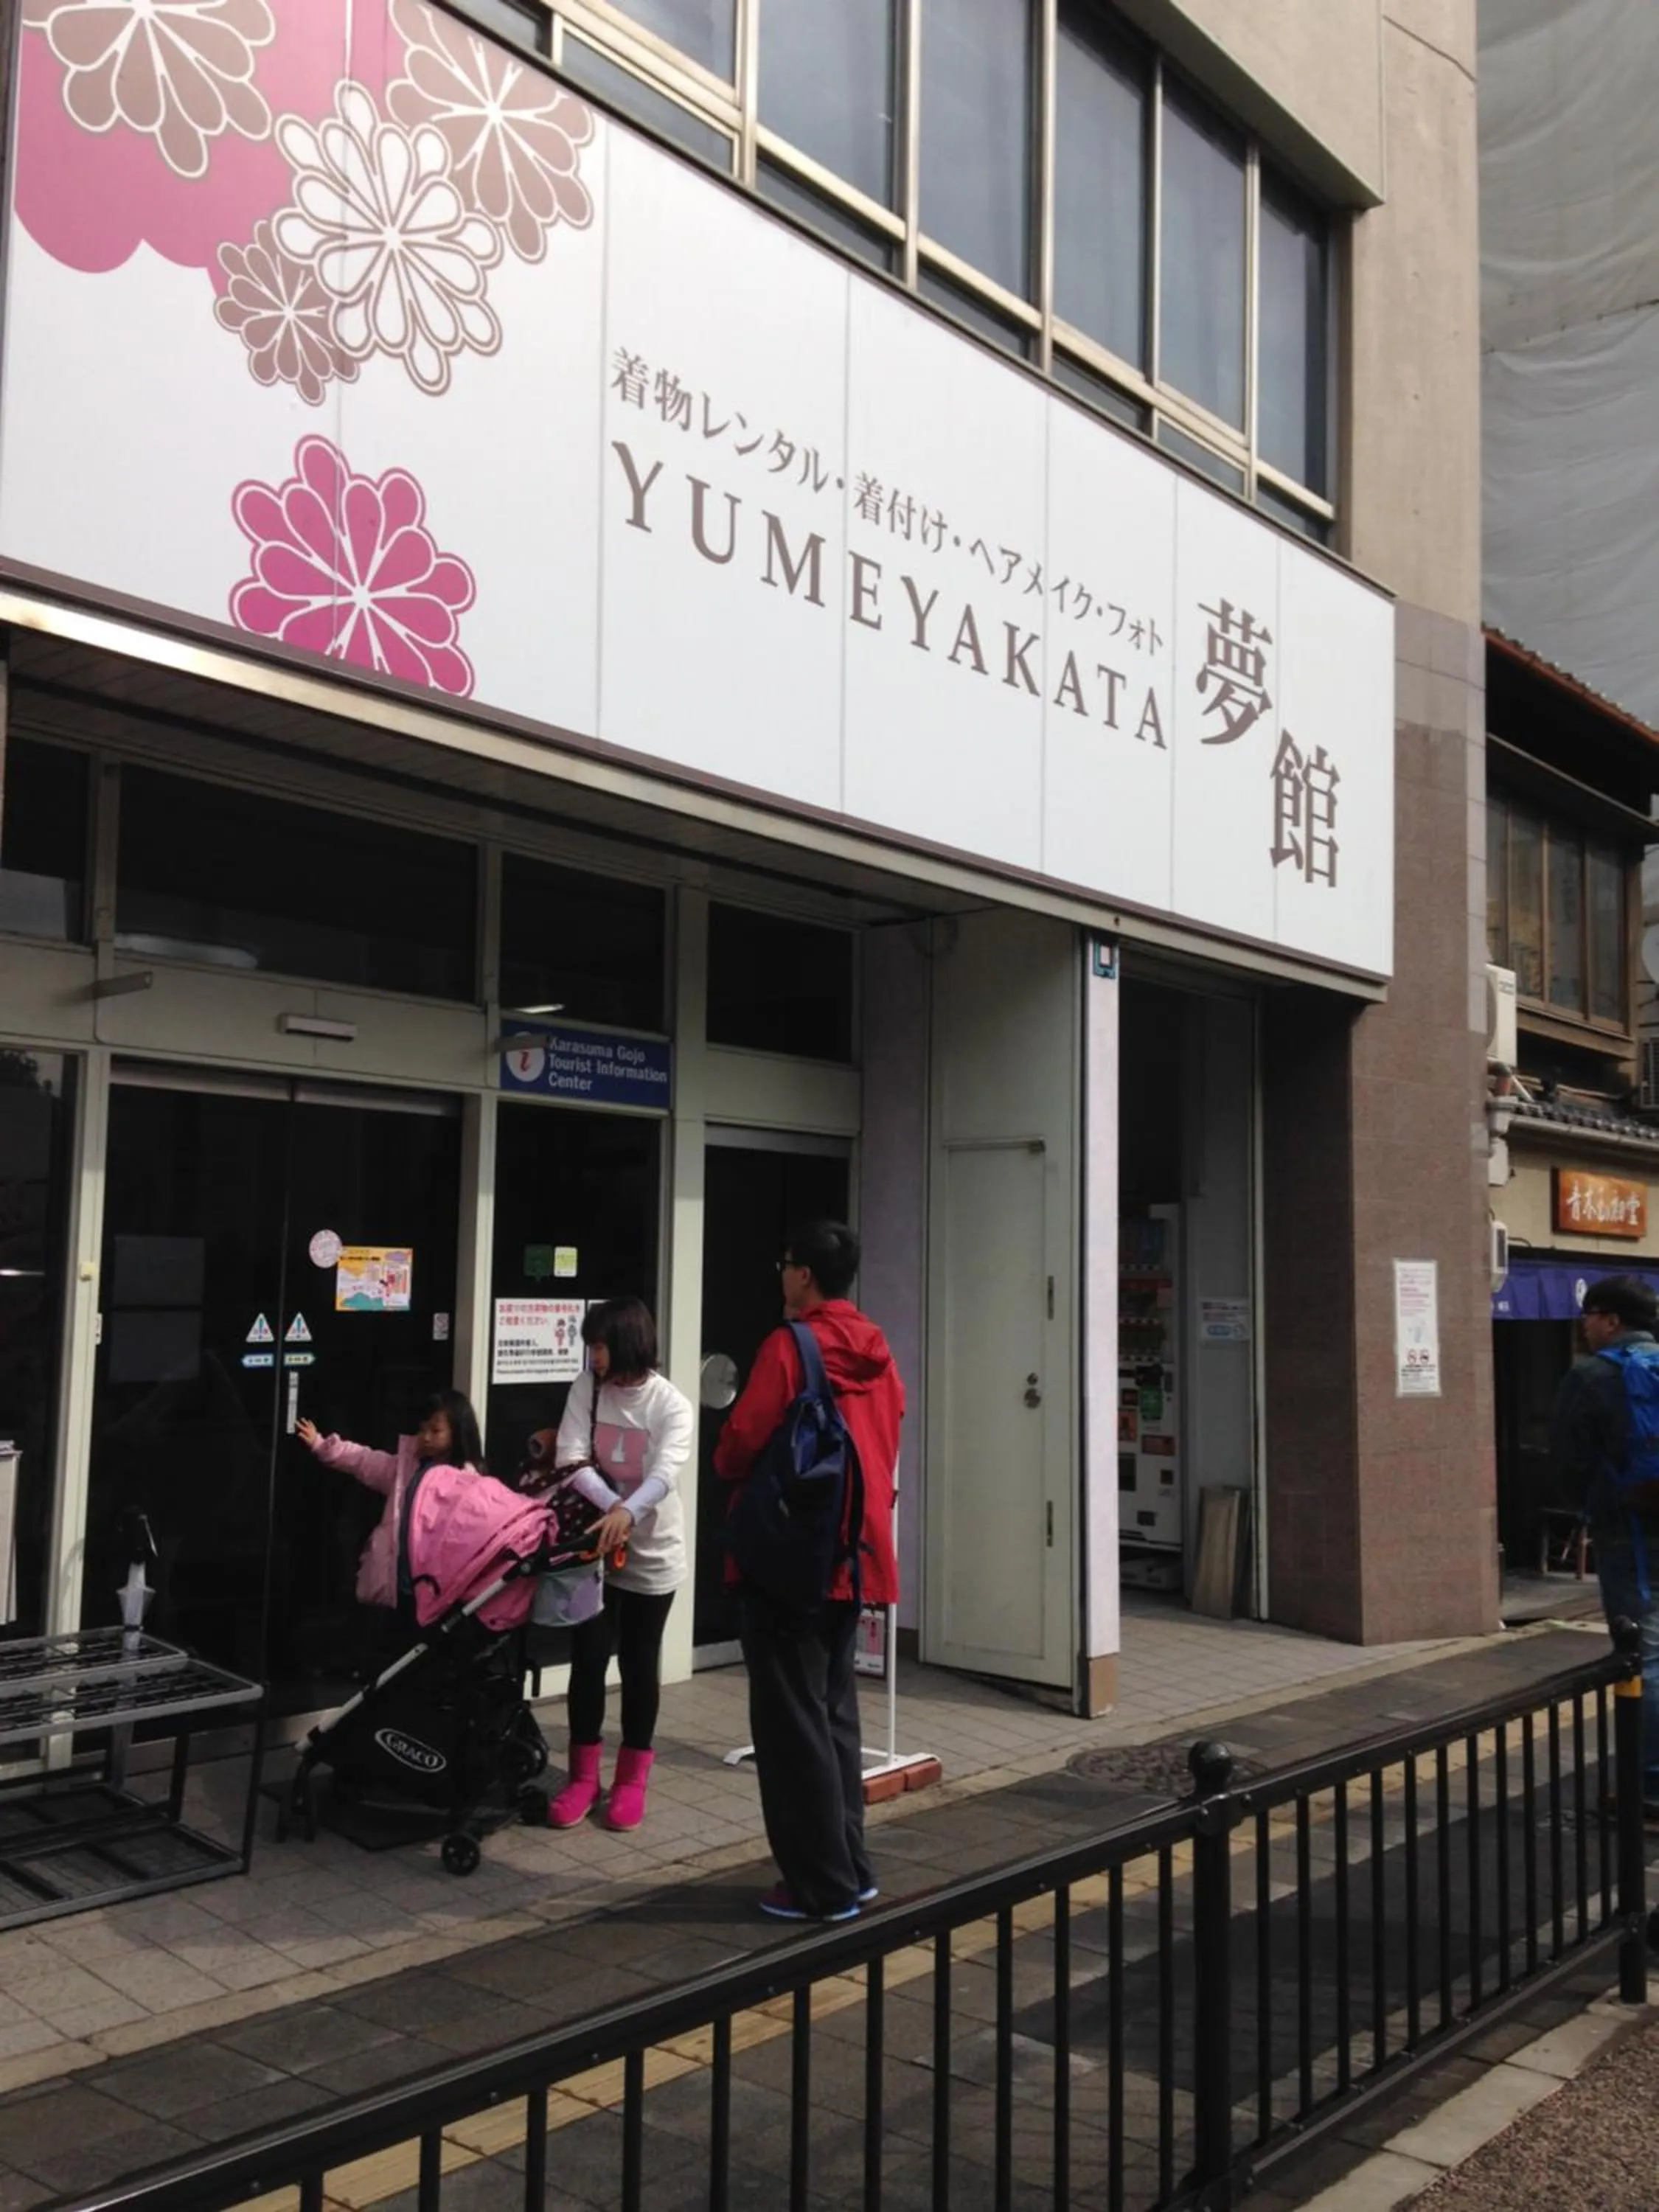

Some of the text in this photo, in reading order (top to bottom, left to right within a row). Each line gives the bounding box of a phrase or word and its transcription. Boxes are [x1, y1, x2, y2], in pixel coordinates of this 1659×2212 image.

[611, 440, 1168, 751] YUMEYAKATA
[1195, 598, 1342, 889] 夢館
[549, 1035, 646, 1065] Karasuma Gojo
[548, 1071, 594, 1091] Center
[549, 1054, 668, 1083] Tourist Information
